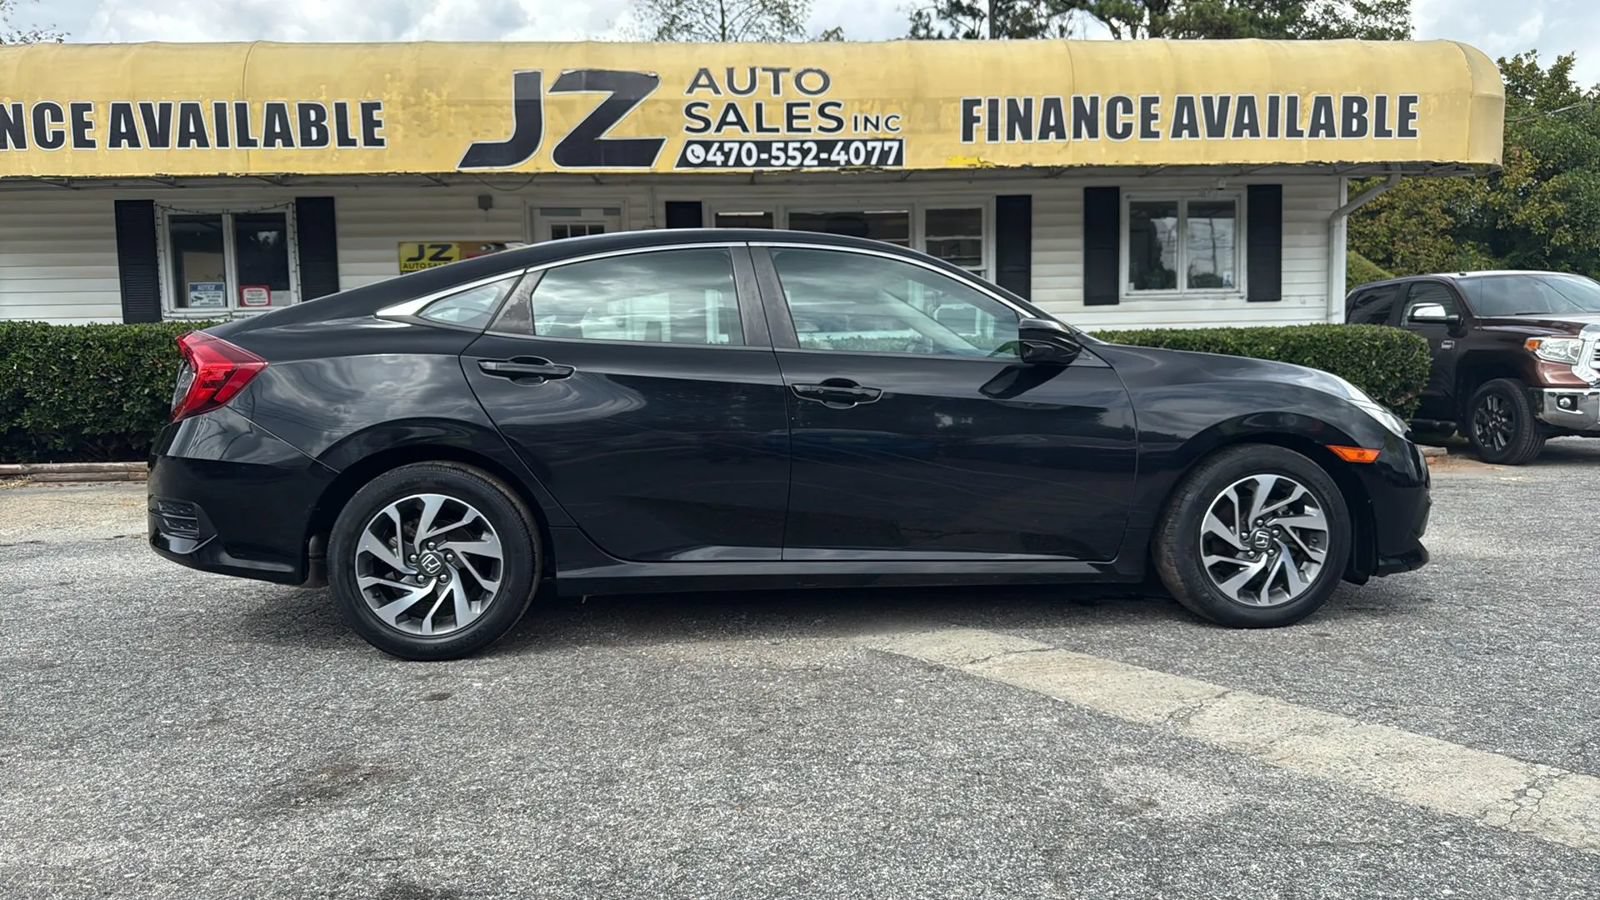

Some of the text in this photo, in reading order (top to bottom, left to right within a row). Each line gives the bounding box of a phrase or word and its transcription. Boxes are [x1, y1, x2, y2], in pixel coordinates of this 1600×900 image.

[684, 66, 832, 97] AUTO
[0, 100, 387, 150] NCE AVAILABLE
[457, 69, 667, 170] JZ
[683, 101, 903, 134] SALES INC
[961, 93, 1420, 144] FINANCE AVAILABLE
[706, 140, 900, 167] 470-552-4077
[406, 244, 454, 262] JZ
